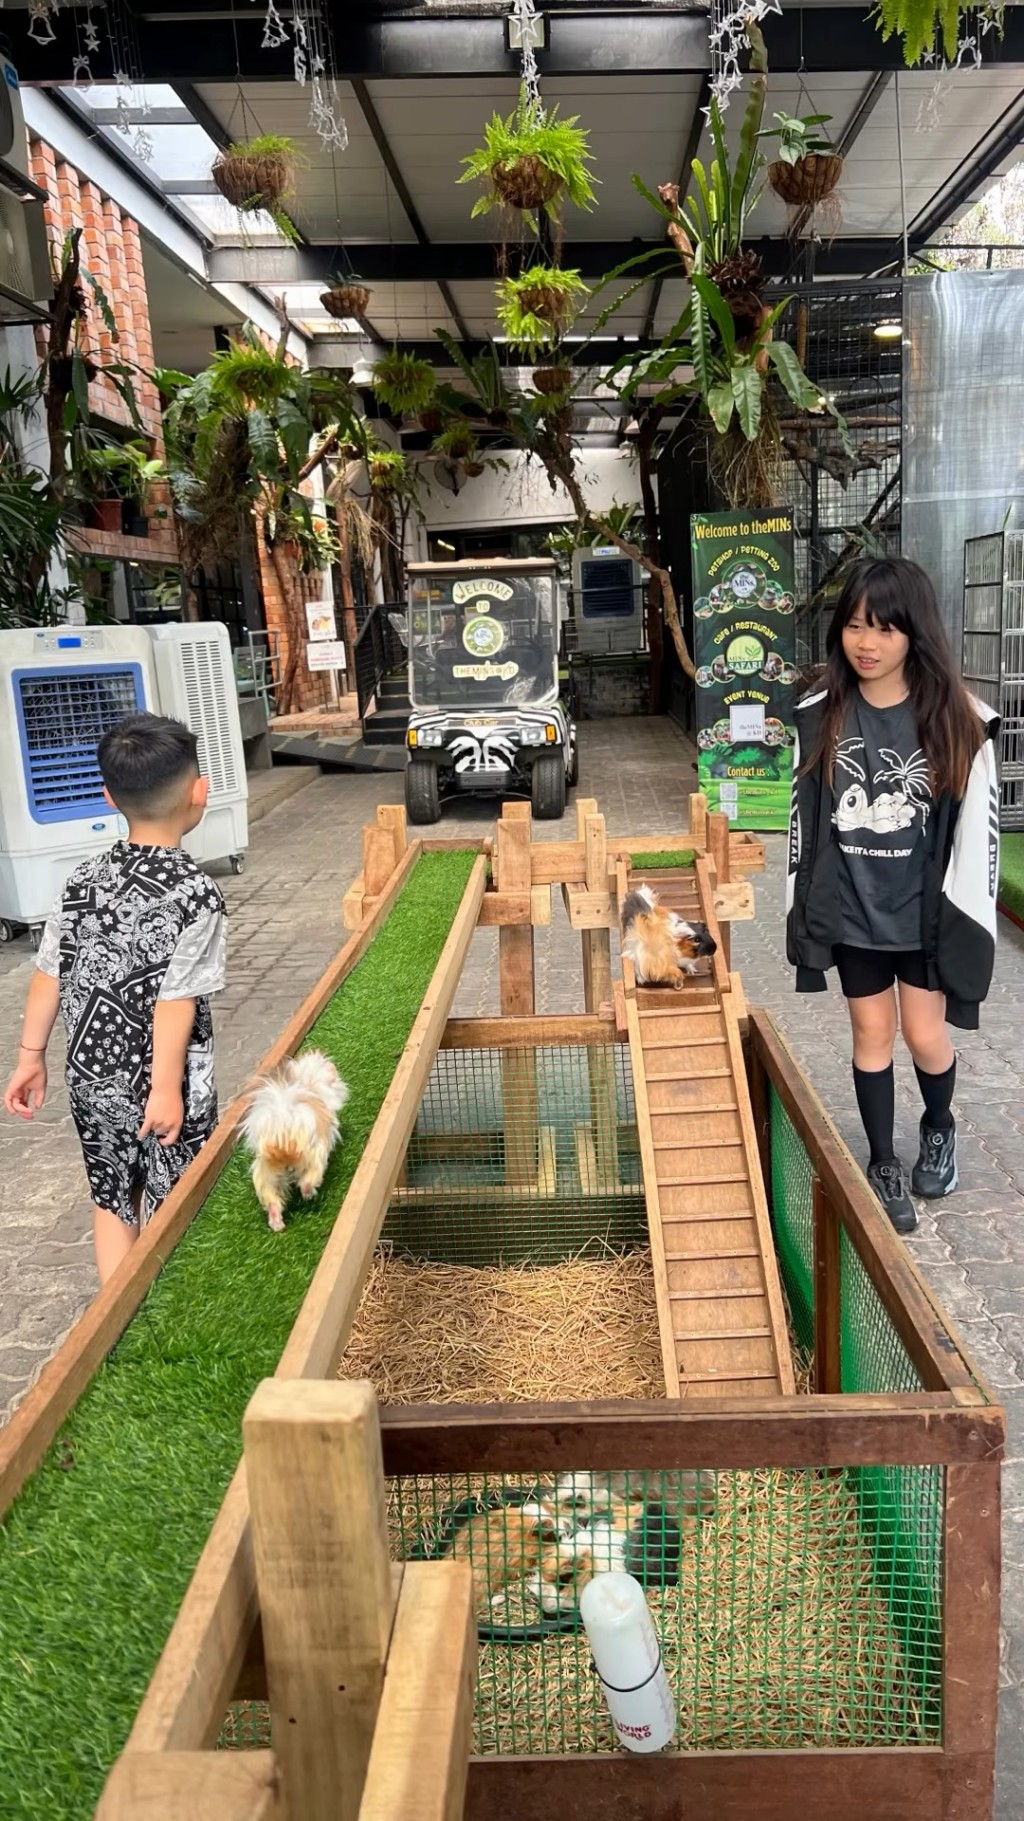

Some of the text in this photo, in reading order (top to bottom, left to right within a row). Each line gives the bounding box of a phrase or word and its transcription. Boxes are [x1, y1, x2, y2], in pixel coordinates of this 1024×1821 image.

[695, 517, 792, 539] Welcome to theMINs
[767, 557, 780, 572] ZOO
[455, 581, 512, 599] WELCOME
[478, 602, 488, 610] TO
[729, 661, 762, 670] SAFARI
[727, 766, 755, 777] Contact
[756, 767, 766, 777] us
[868, 848, 893, 858] CHILL
[893, 848, 913, 858] DAY
